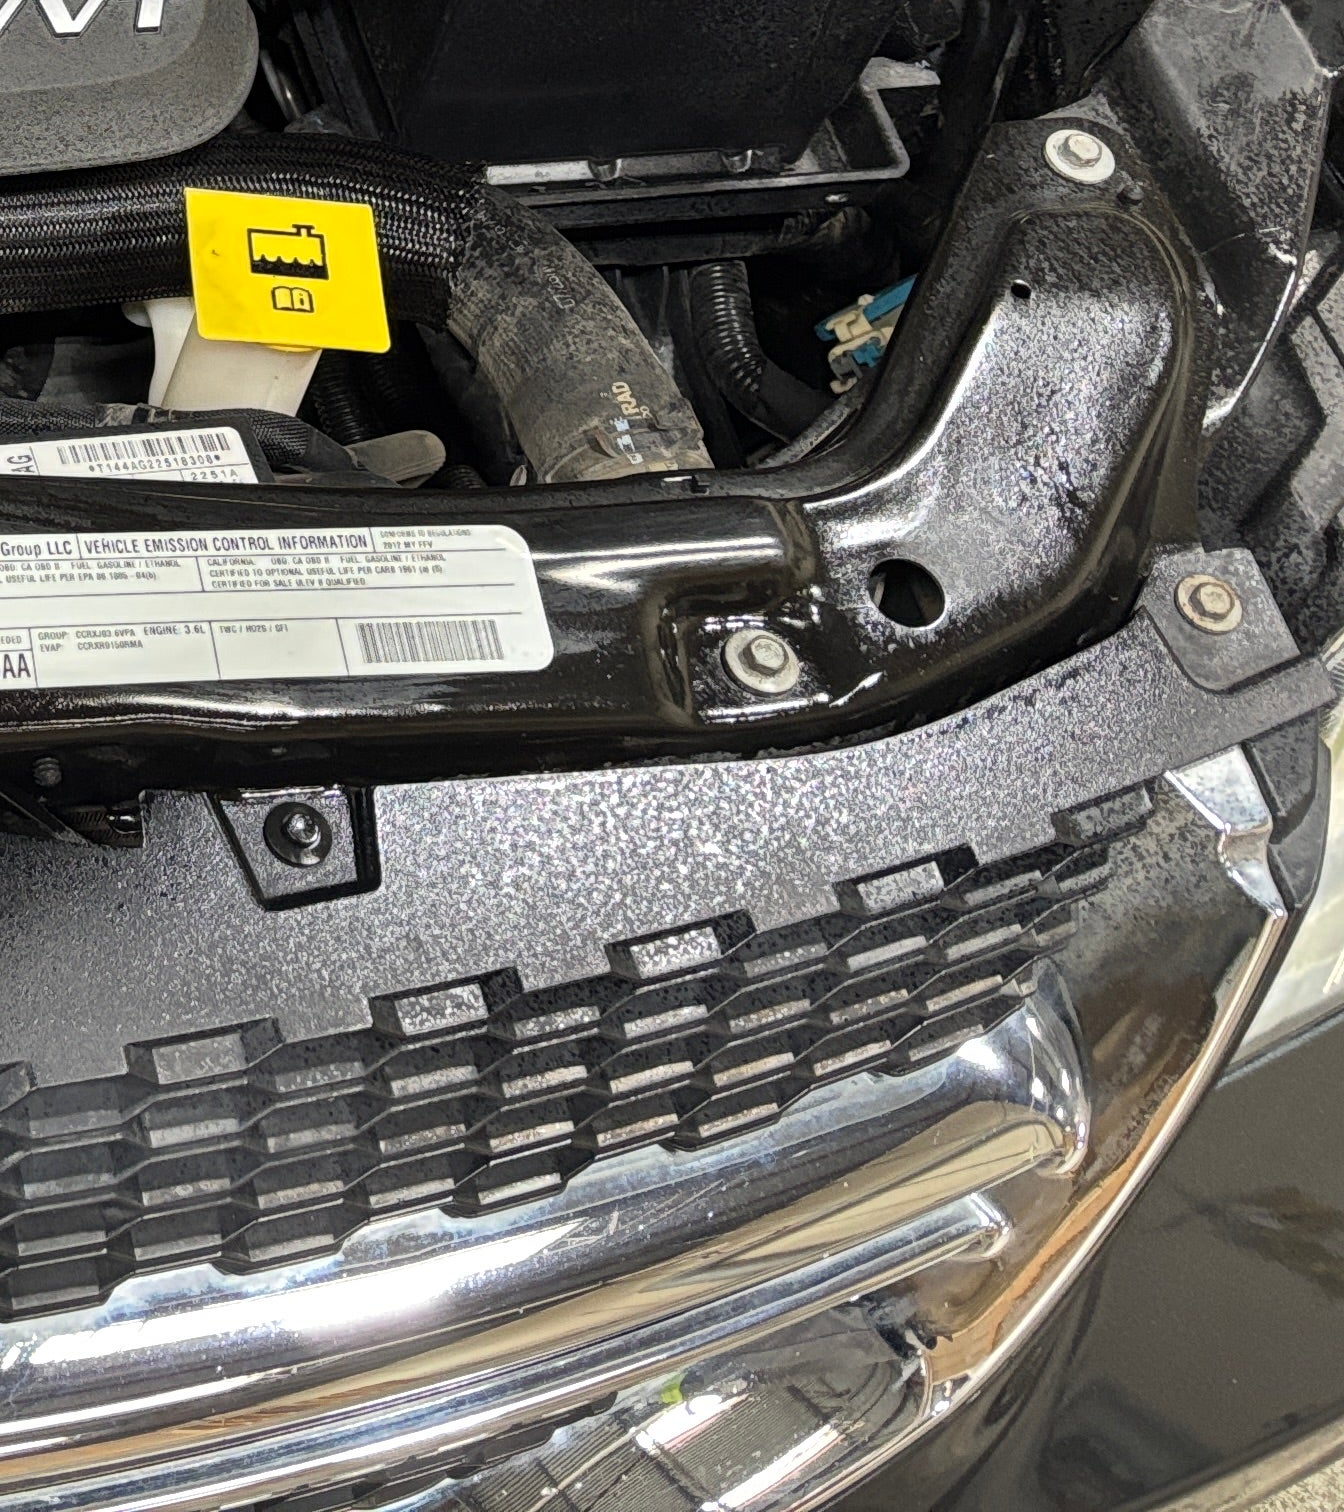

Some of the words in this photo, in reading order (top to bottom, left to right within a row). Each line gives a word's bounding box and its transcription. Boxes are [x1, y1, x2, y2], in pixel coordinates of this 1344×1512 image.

[0, 542, 42, 558] Group
[46, 540, 72, 555] LLC
[83, 538, 140, 554] VEHICLE
[143, 537, 208, 553] EMISSION
[212, 536, 274, 551] CONTROL
[277, 534, 367, 550] INFORMATION
[418, 540, 433, 548] FFV
[184, 625, 206, 634] 3.6L
